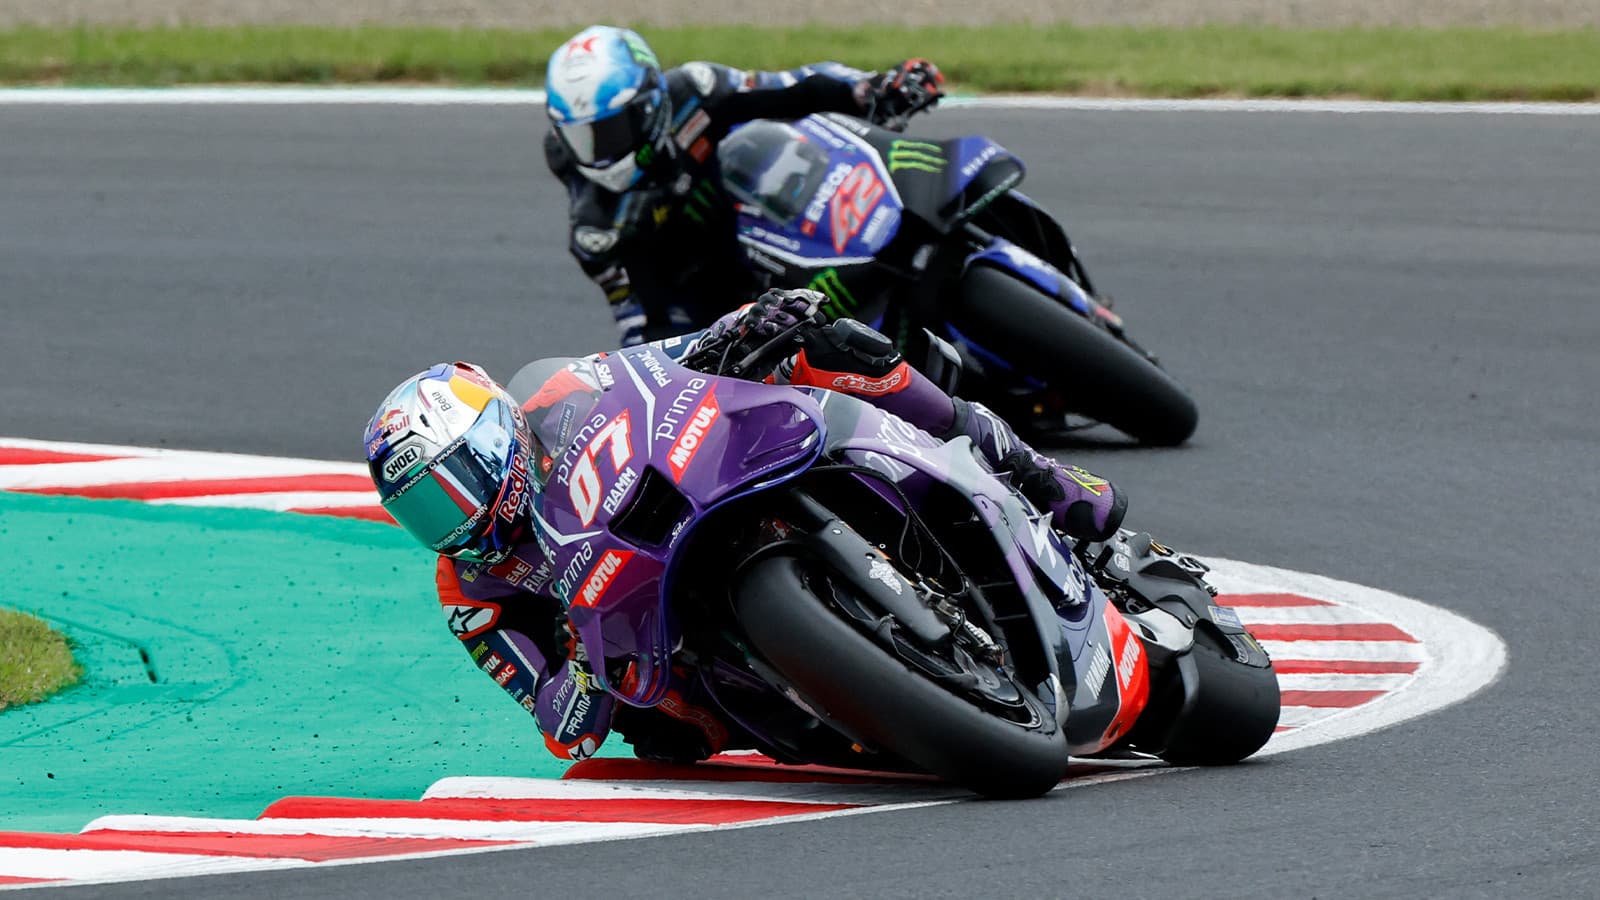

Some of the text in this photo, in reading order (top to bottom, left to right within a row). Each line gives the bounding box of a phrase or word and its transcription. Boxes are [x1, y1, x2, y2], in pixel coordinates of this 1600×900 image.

[830, 162, 886, 254] 42
[432, 391, 452, 412] Beta
[656, 378, 706, 440] prima
[386, 448, 418, 478] SHOEI
[558, 413, 606, 486] prima
[670, 405, 717, 468] MOTUL
[570, 408, 634, 528] 07
[603, 467, 637, 515] FIAMM
[455, 503, 489, 535] Otomotiv
[559, 541, 593, 604] prima
[583, 552, 622, 606] MOTUL
[1084, 642, 1112, 700] YAMAHA
[1117, 632, 1140, 690] MOTUL
